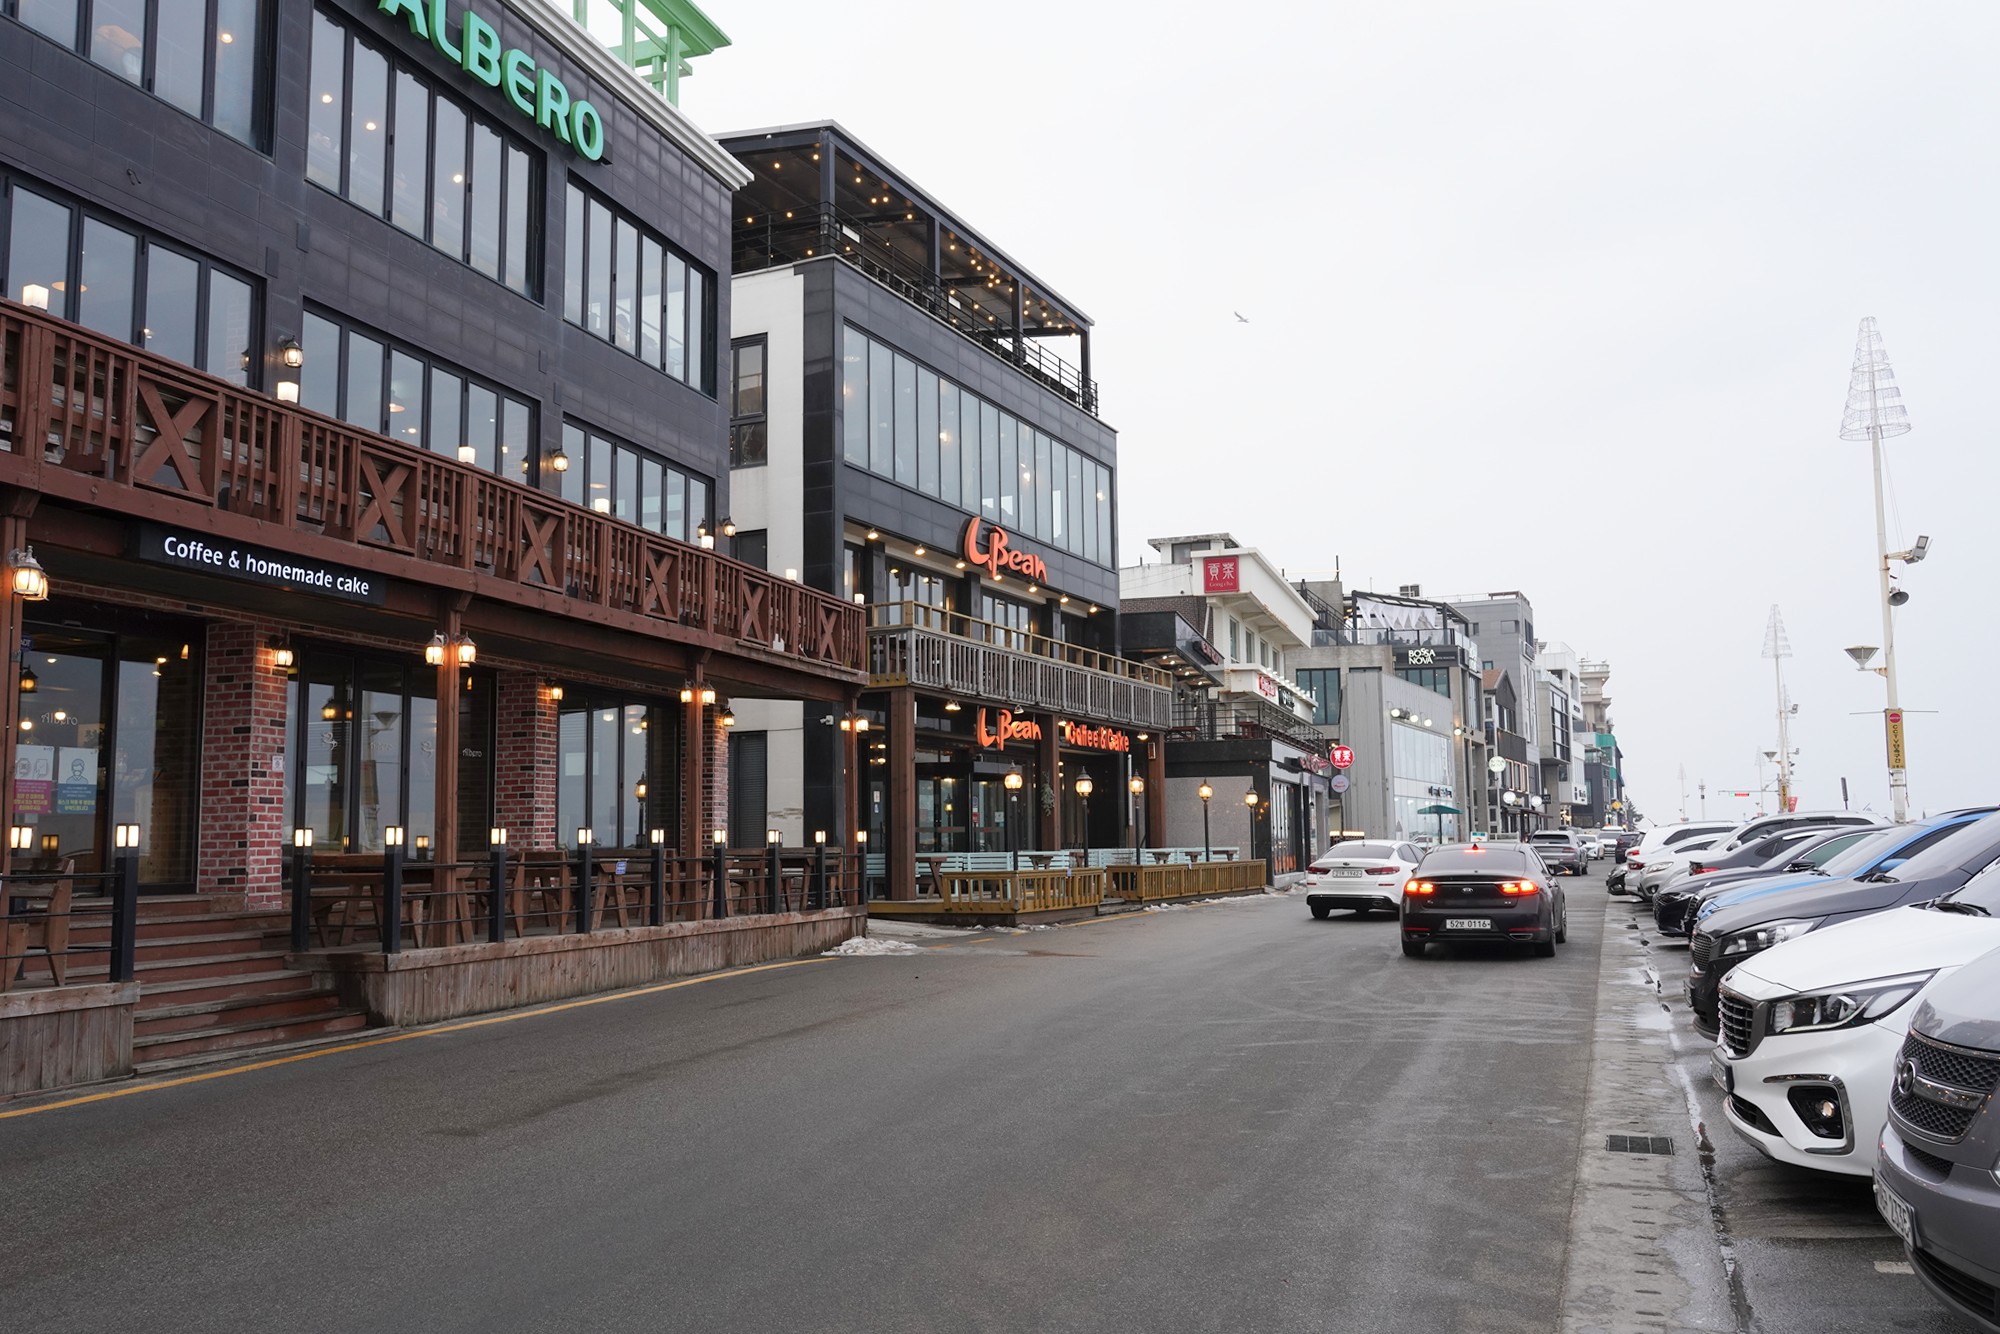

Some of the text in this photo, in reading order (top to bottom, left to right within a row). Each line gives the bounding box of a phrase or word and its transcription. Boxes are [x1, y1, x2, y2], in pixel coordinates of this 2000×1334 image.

[164, 536, 369, 596] Coffee & homemade cake
[1408, 647, 1436, 657] BOSSA
[1408, 656, 1433, 665] NOVA
[1065, 721, 1099, 748] Coffee
[1107, 728, 1129, 752] Cake
[1467, 920, 1487, 928] 0116
